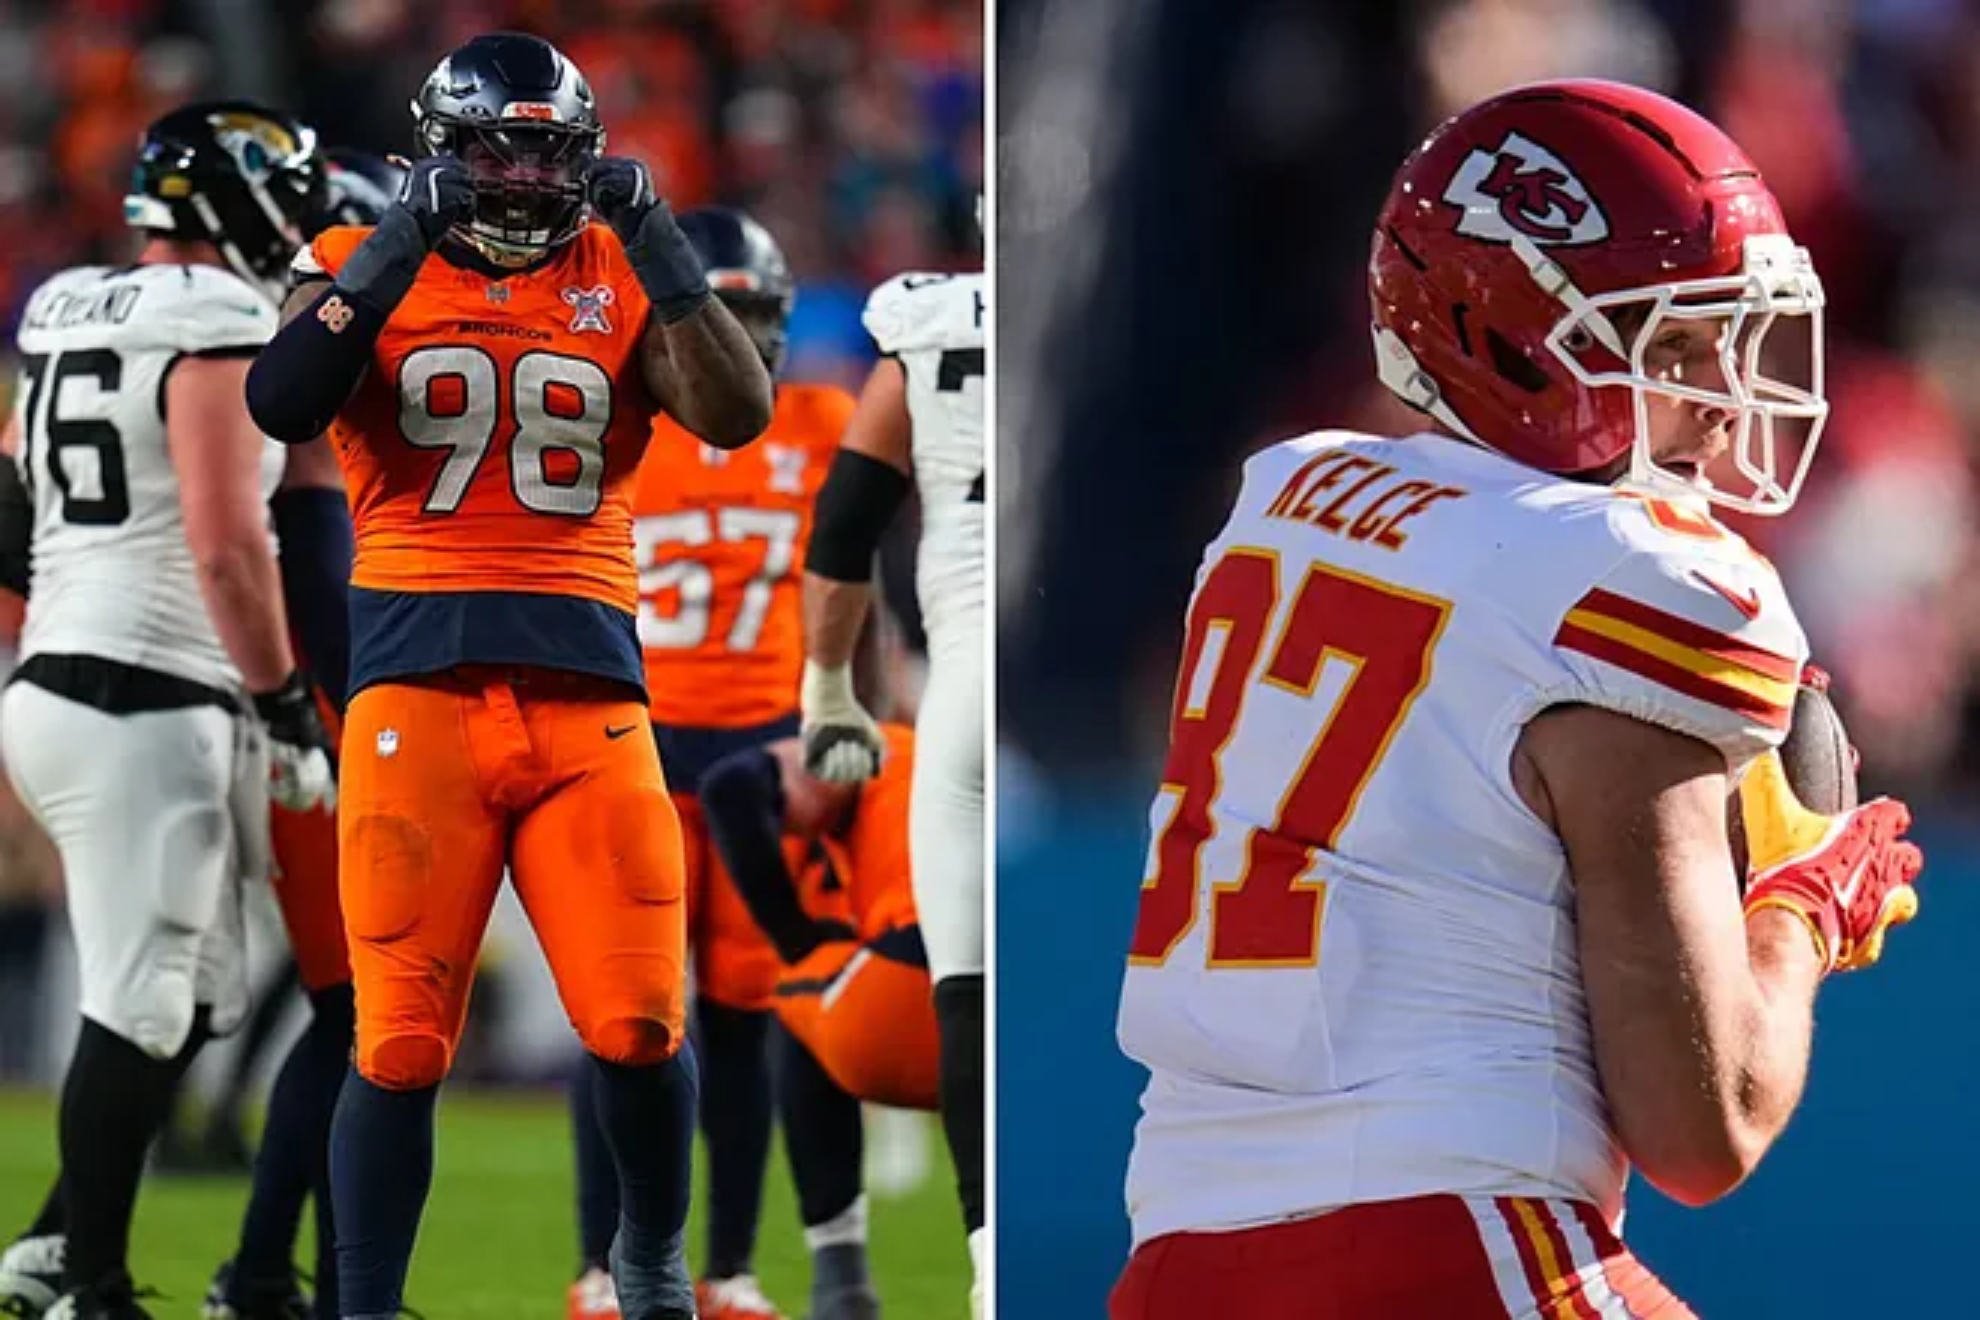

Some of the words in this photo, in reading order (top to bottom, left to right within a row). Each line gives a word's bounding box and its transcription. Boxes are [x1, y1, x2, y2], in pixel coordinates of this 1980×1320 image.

[1477, 153, 1590, 240] KC
[22, 348, 131, 526] 76
[396, 343, 615, 518] 98
[1264, 447, 1470, 552] KELCE
[633, 508, 800, 652] 57
[1128, 545, 1454, 968] 87
